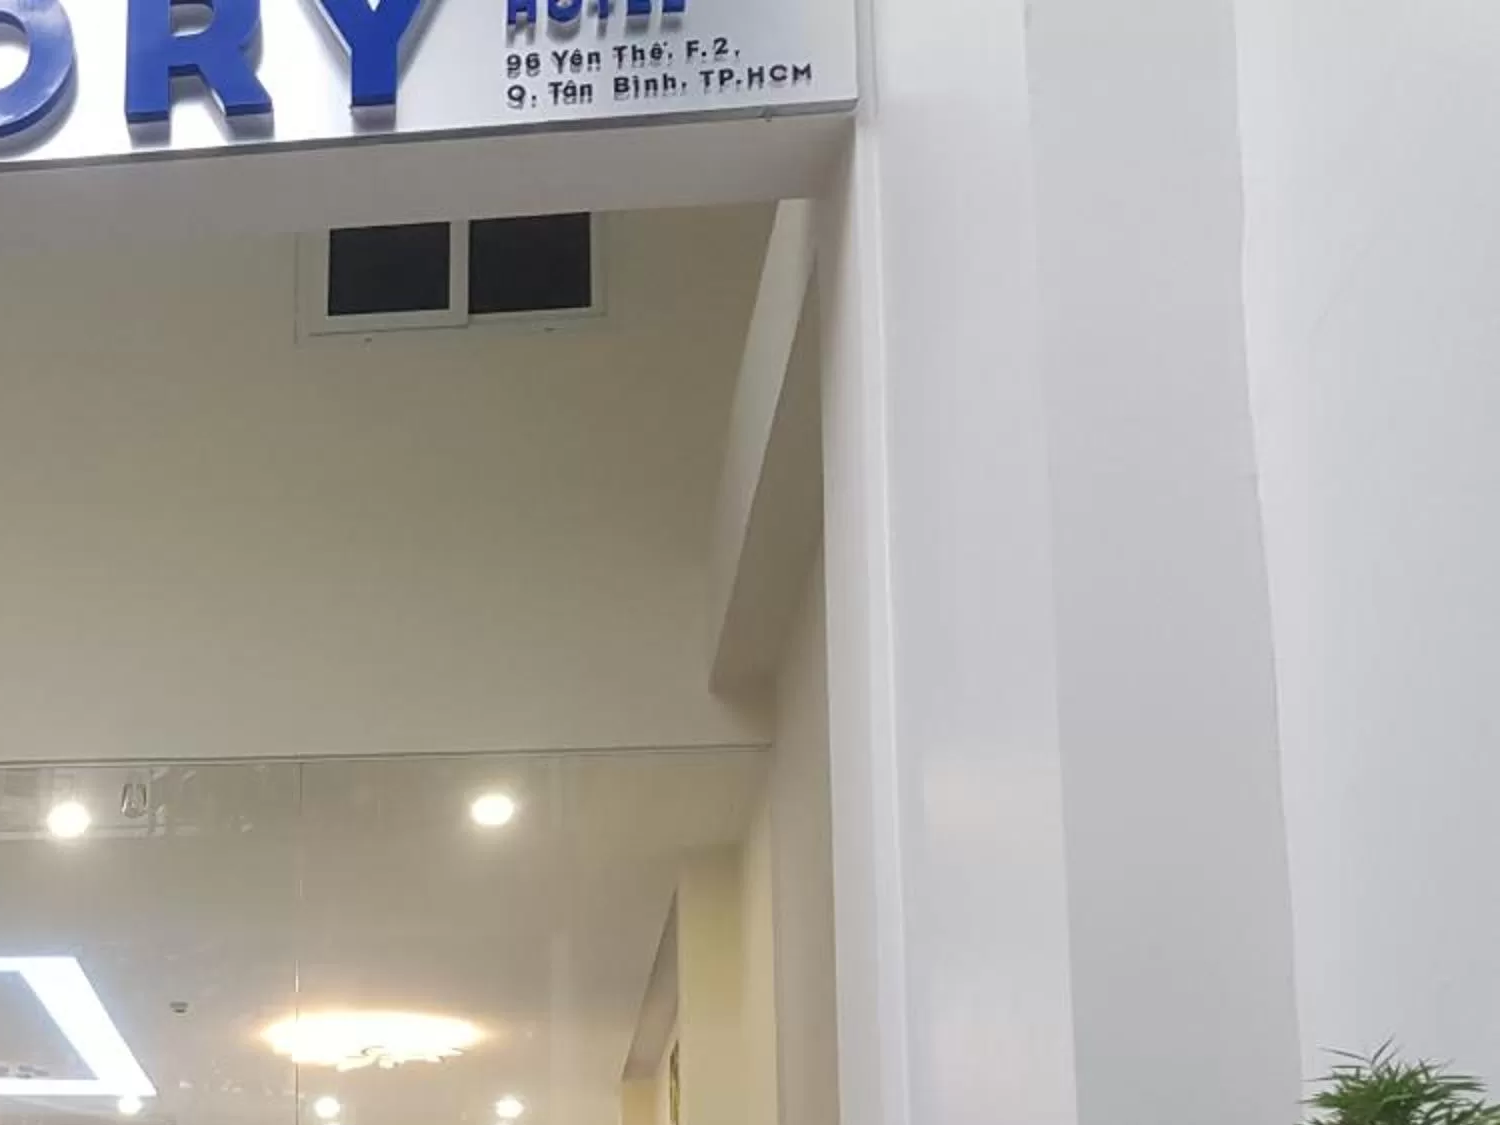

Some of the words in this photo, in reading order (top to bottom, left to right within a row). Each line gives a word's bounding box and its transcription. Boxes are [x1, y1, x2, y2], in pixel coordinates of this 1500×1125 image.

[551, 48, 601, 73] Yên
[506, 84, 537, 105] Q.
[548, 79, 594, 104] Tân
[699, 63, 812, 88] TP.HCM
